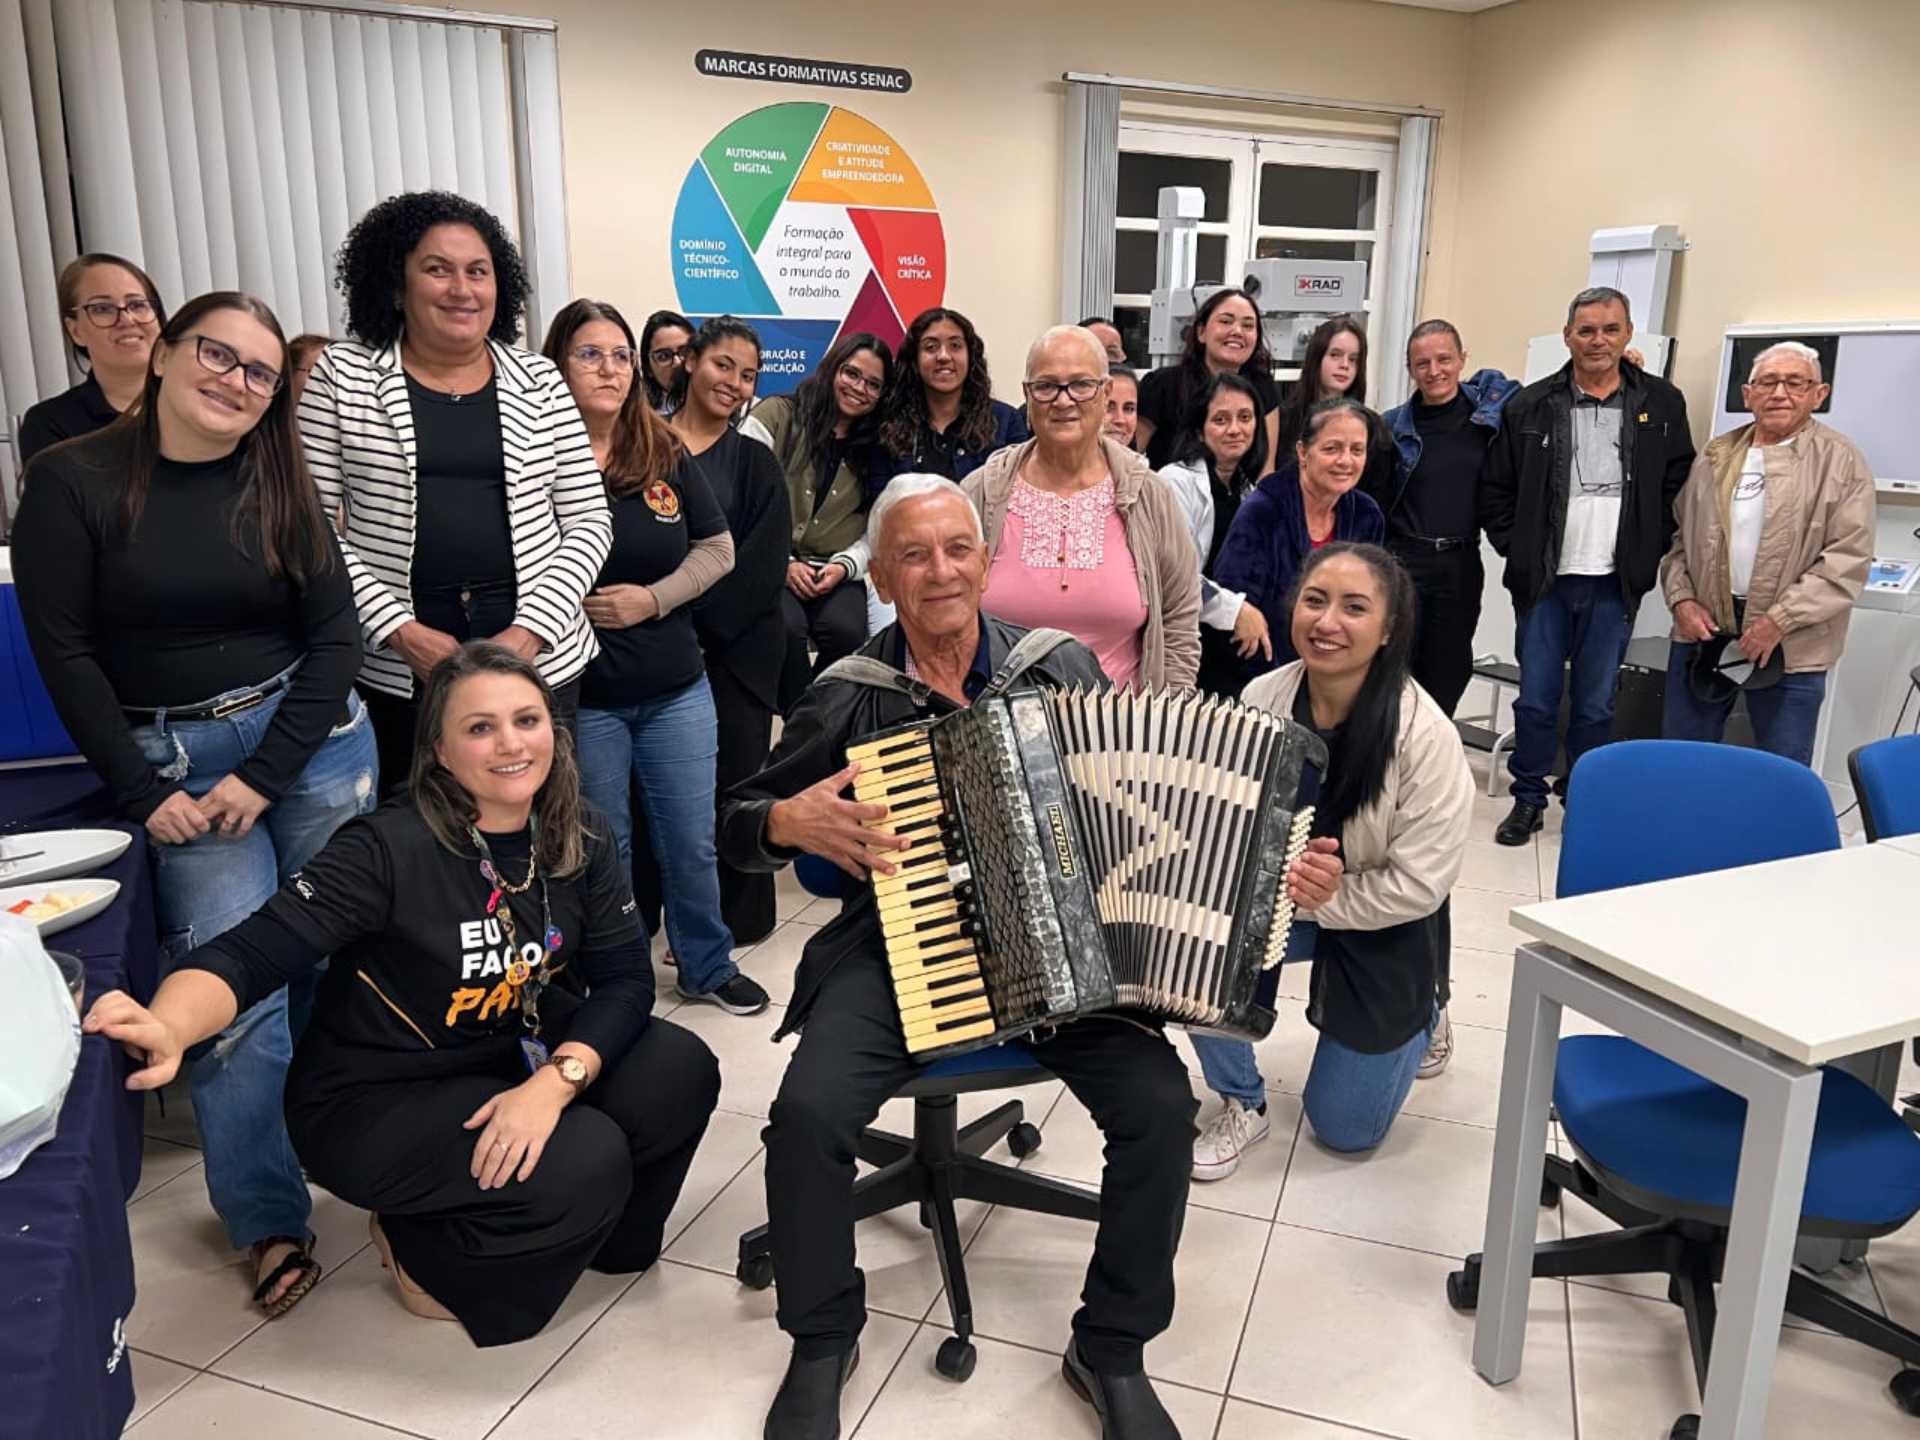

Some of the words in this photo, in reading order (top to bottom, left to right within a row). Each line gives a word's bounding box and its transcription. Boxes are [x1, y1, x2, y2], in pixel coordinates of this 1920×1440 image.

[705, 56, 766, 76] MARCAS
[769, 63, 858, 84] FORMATIVAS
[860, 72, 904, 89] SENAC
[725, 147, 787, 161] AUTONOMIA
[825, 141, 891, 156] CRIATIVIDADE
[733, 162, 773, 174] DIGITAL
[838, 156, 844, 166] E
[846, 157, 885, 169] ATITUDE
[821, 168, 905, 184] EMPREENDEDORA
[783, 224, 844, 241] Formação
[680, 238, 727, 251] DOMÍNIO
[684, 252, 731, 265] TÉCNICO-
[776, 245, 823, 261] integral
[824, 249, 852, 262] para
[897, 254, 926, 266] VISÃO
[684, 267, 740, 279] CIENTÍFICO
[779, 267, 788, 277] o
[790, 265, 832, 279] mundo
[834, 266, 850, 280] do
[897, 268, 933, 280] CRÍTICA
[788, 284, 841, 298] trabalho.
[800, 350, 807, 360] E
[1048, 806, 1073, 875] MICHAEL
[460, 918, 502, 950] EU
